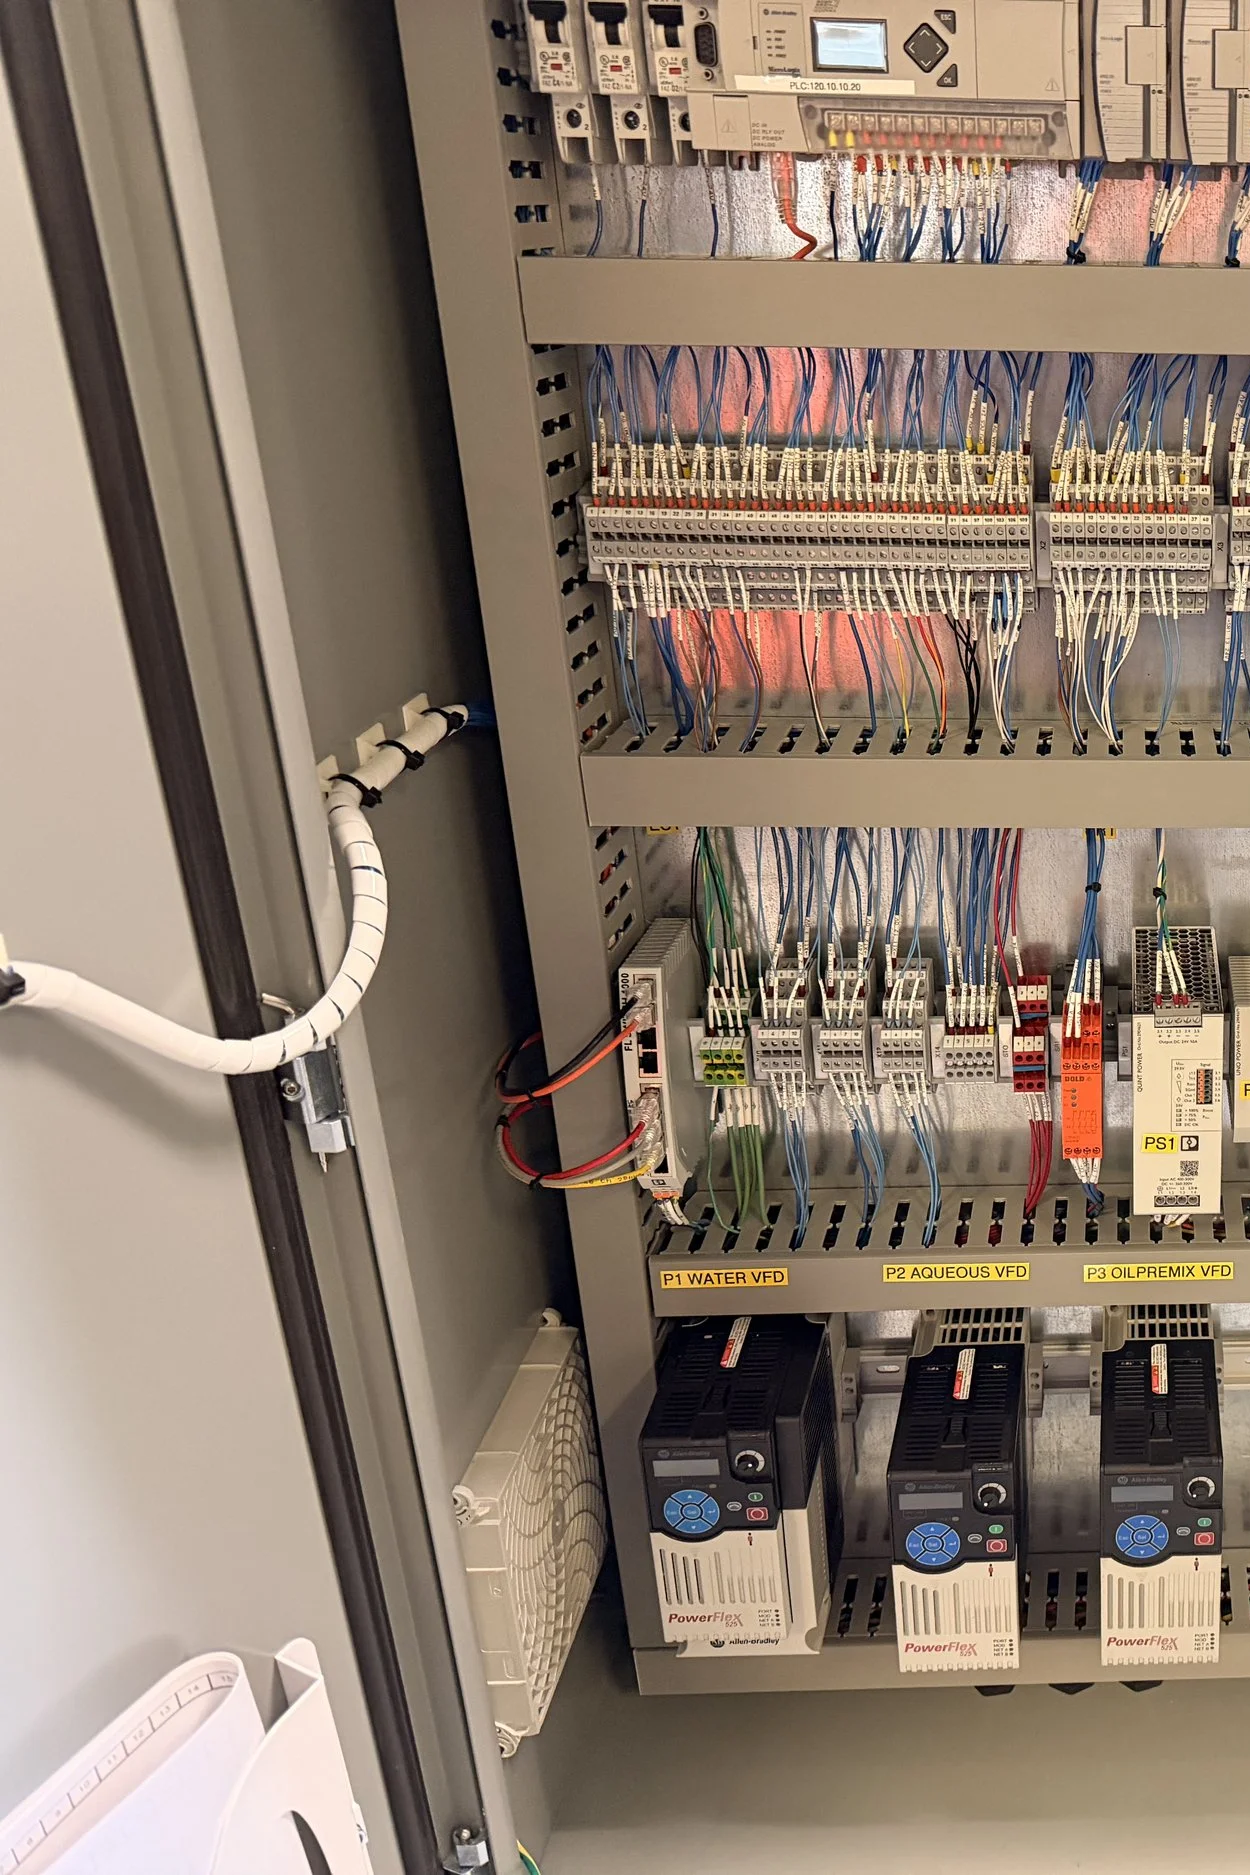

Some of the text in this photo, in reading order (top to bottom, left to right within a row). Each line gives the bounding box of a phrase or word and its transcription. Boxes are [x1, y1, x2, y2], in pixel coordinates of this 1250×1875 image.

[789, 81, 861, 92] PLC:120.10.10.20
[1040, 541, 1046, 550] X2
[1217, 542, 1224, 551] X3
[624, 1040, 632, 1051] FL
[1144, 1136, 1174, 1150] PS1
[663, 1270, 785, 1285] P1 WATER VFD
[886, 1265, 1027, 1280] P2 AQUEOUS VFD
[1088, 1264, 1232, 1280] P3 OILPREMIX VFD
[668, 1612, 744, 1627] PowerFlex
[904, 1642, 977, 1656] PowerFlex
[1106, 1636, 1178, 1650] PowerFlex
